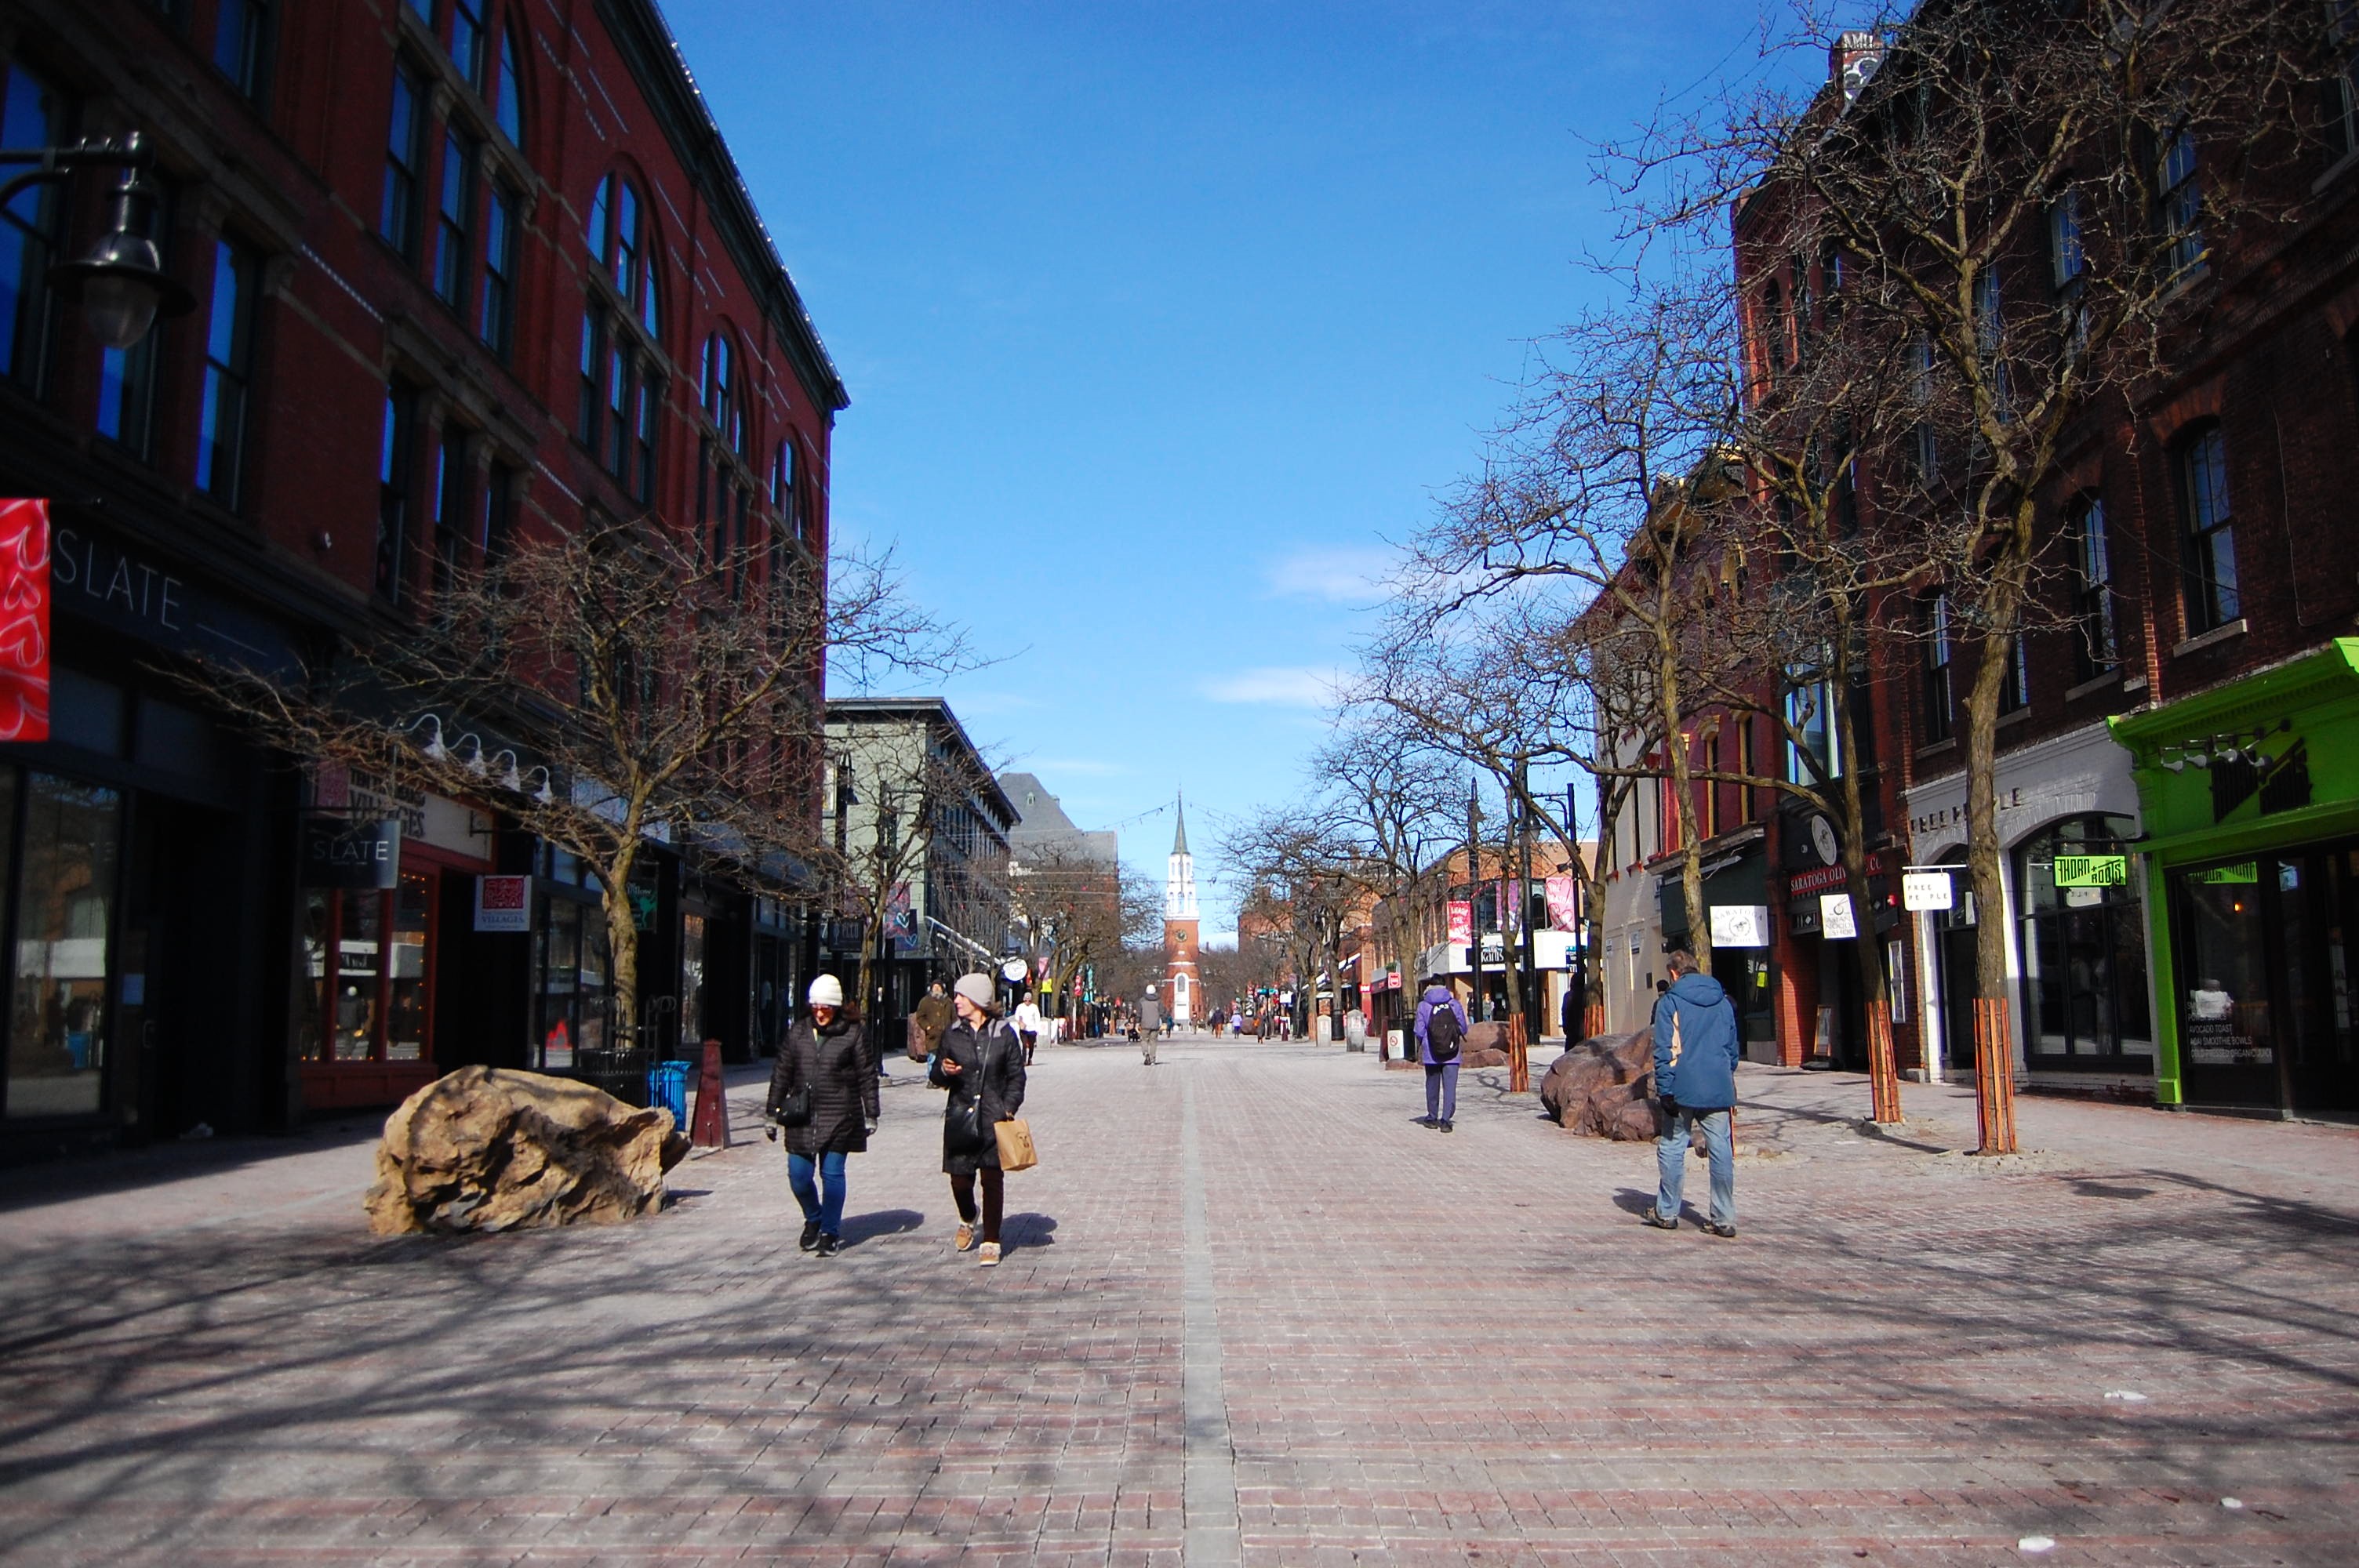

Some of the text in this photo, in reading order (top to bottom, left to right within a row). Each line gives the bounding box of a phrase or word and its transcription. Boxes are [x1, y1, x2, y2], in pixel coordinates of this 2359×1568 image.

[53, 528, 182, 631] SLATE
[1910, 808, 1946, 833] FREE
[314, 840, 389, 860] SLATE
[1790, 871, 1827, 892] SARATOGA
[2055, 858, 2090, 884] THORN
[2092, 858, 2123, 886] ROOTS
[482, 915, 525, 924] VILLAGES
